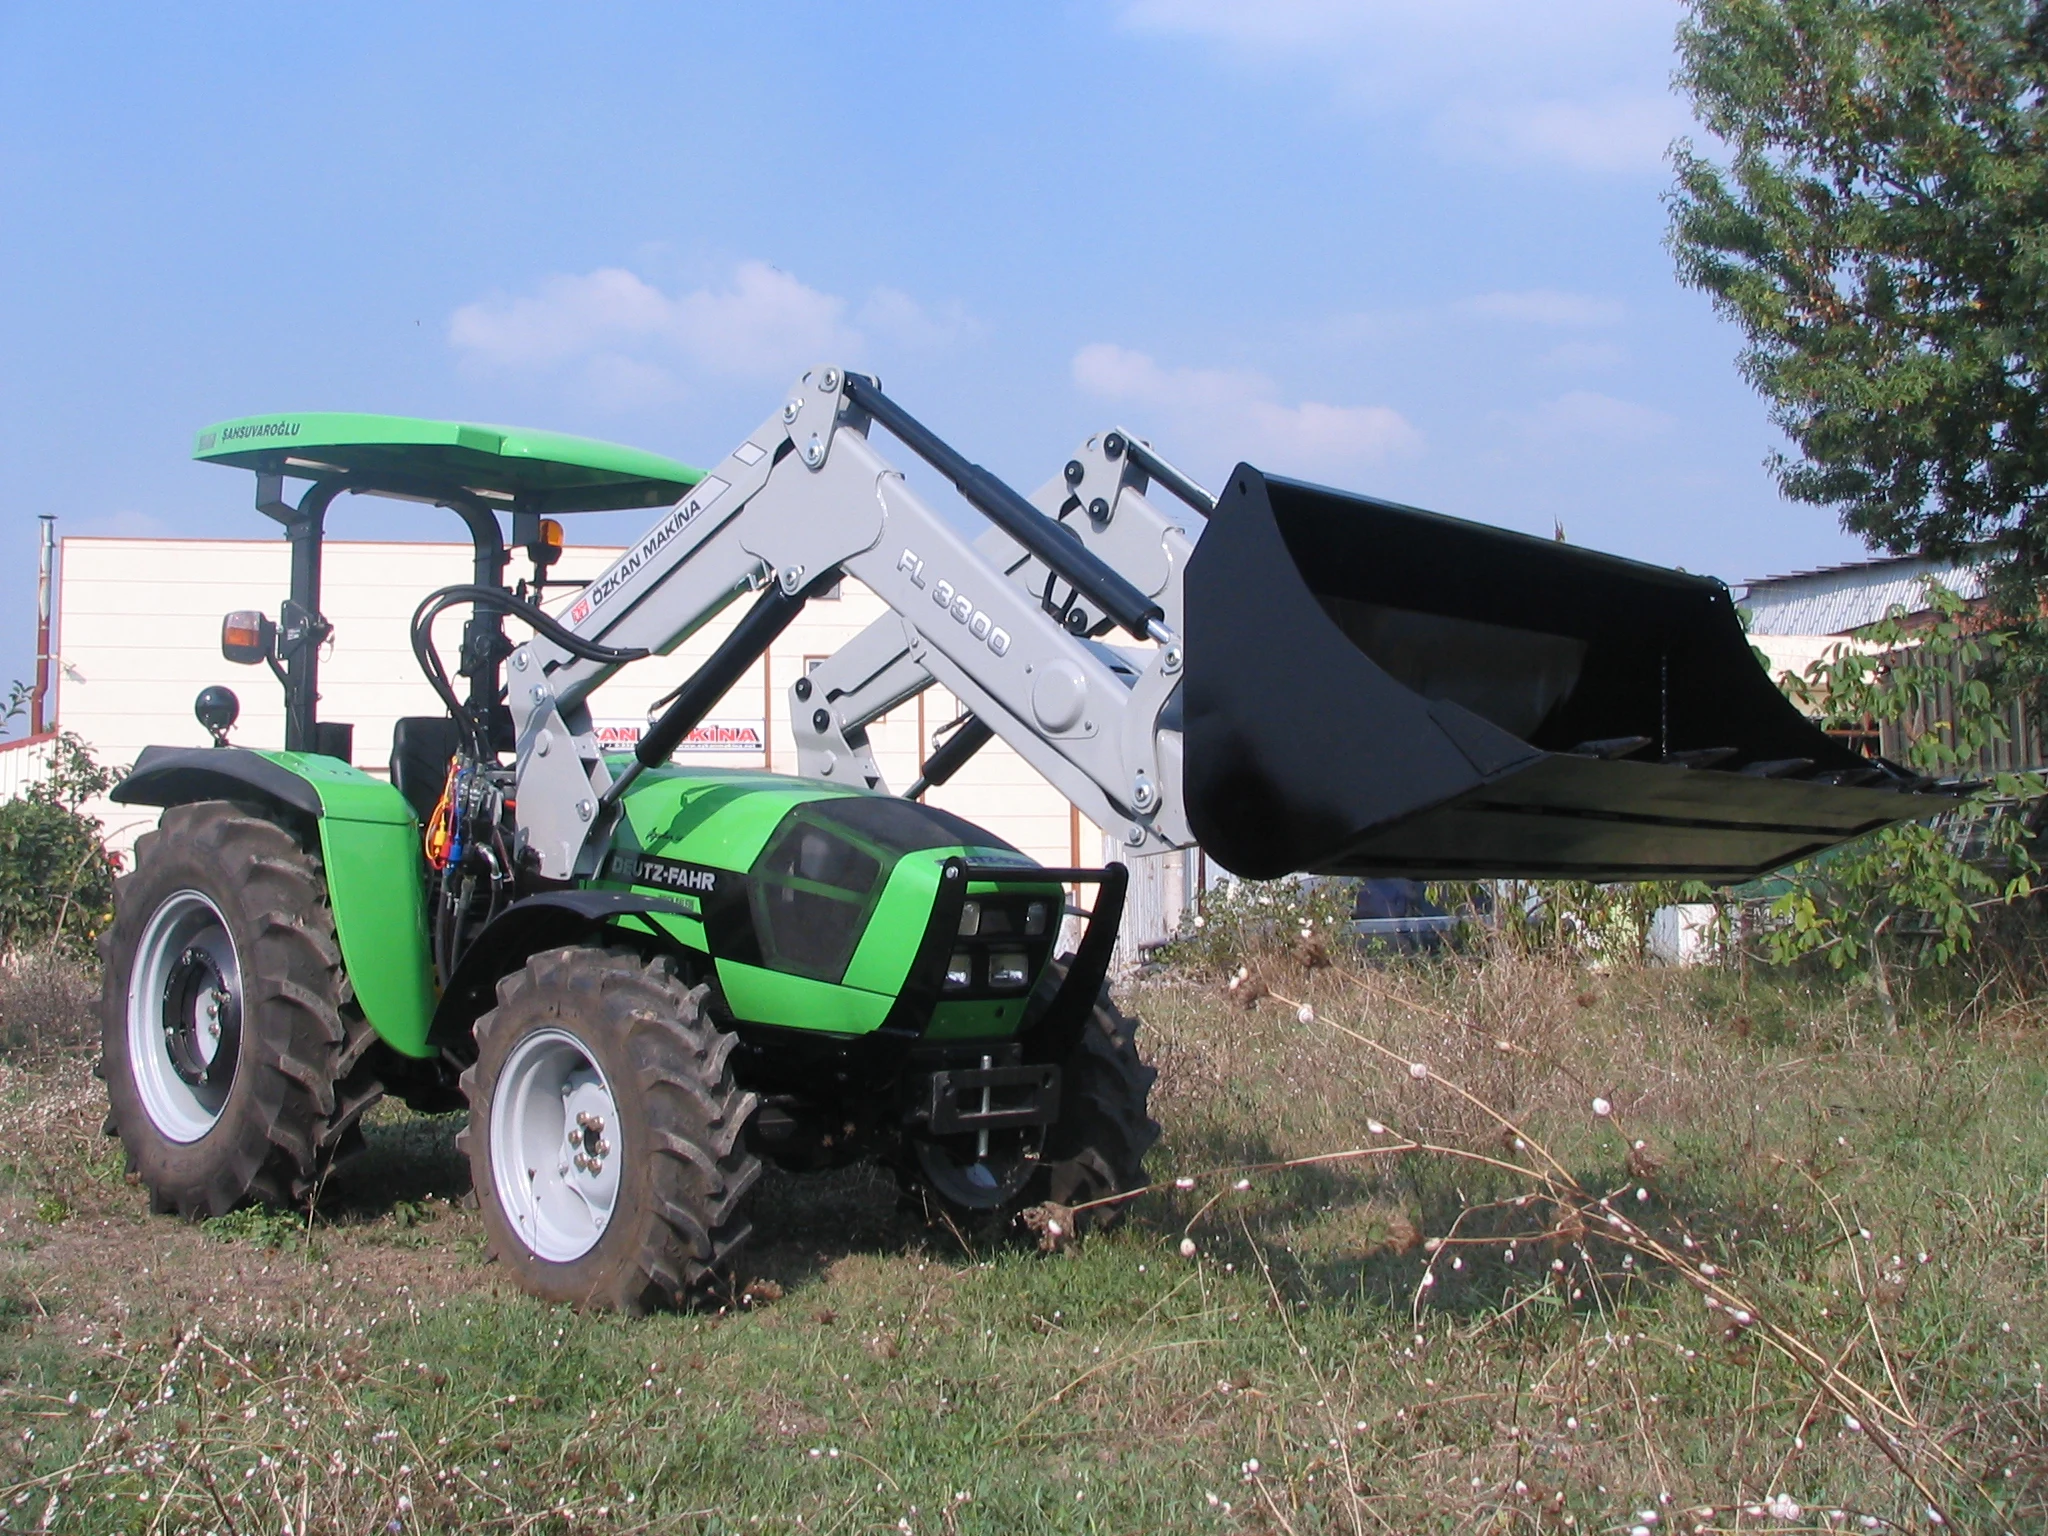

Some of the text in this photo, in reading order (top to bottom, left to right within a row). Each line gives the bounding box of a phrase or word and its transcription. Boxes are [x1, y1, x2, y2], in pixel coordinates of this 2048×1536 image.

[591, 499, 701, 607] ÖZKAN MAKİNA
[897, 547, 1012, 658] FL 3300
[682, 725, 760, 742] KİNA
[612, 855, 717, 892] DEUTZ-FAHR
